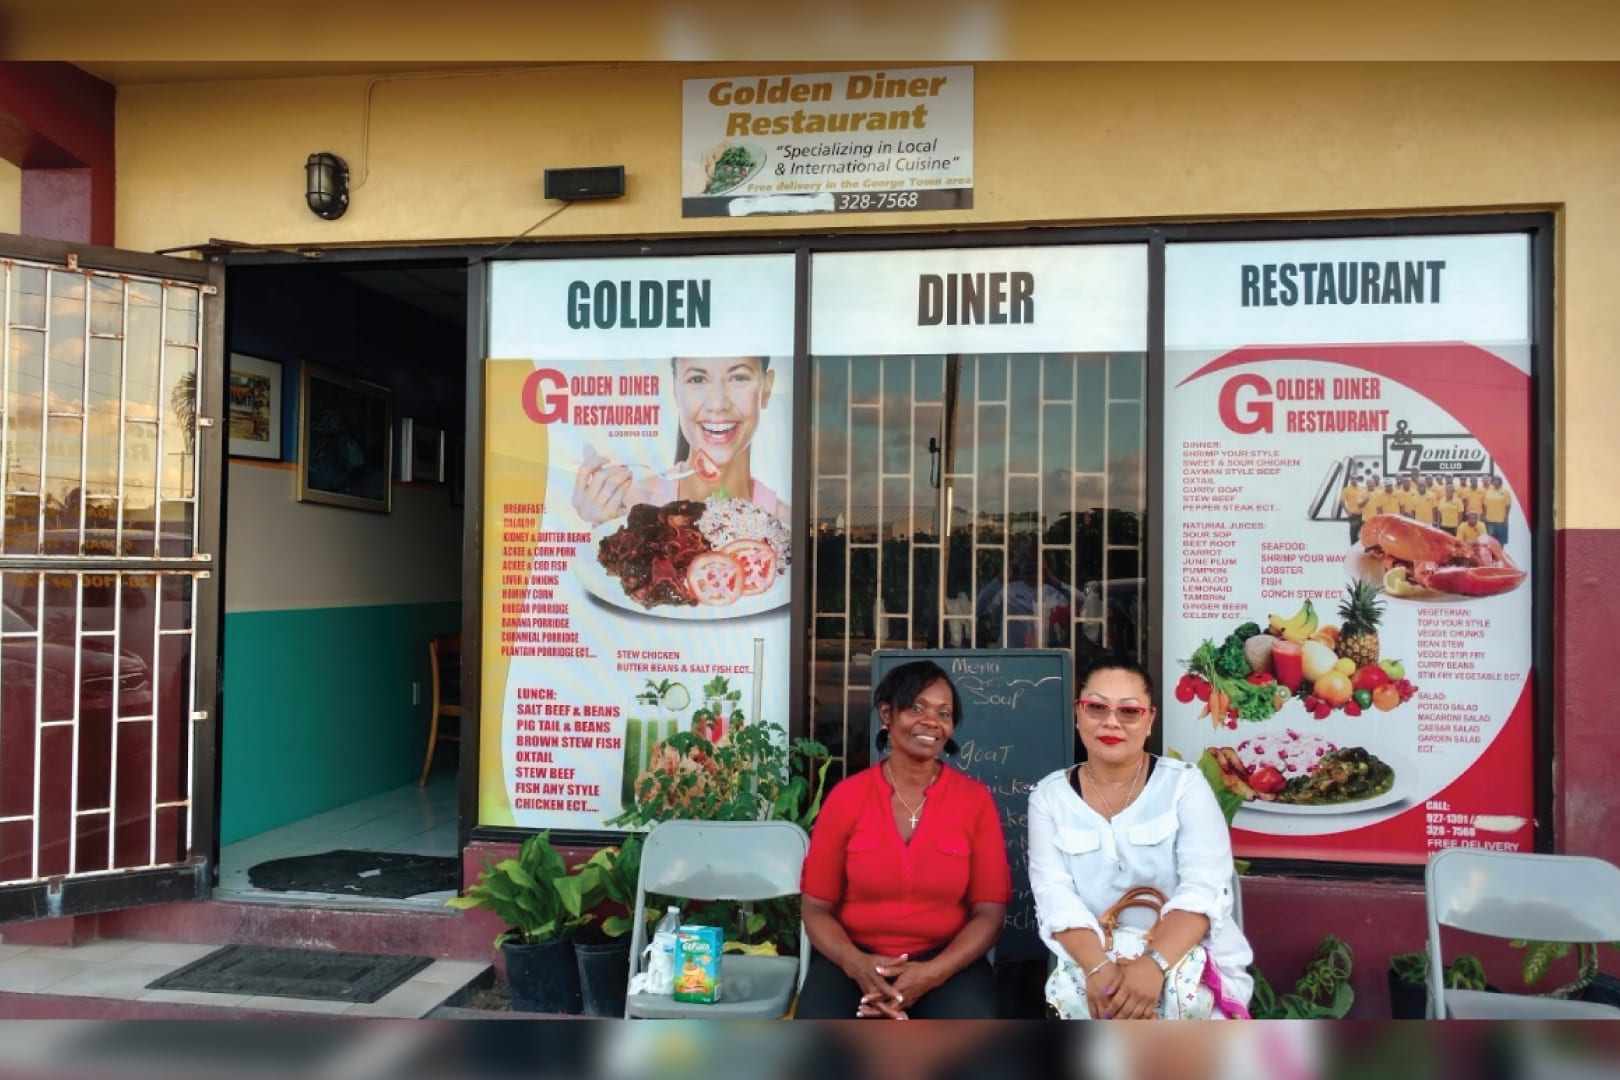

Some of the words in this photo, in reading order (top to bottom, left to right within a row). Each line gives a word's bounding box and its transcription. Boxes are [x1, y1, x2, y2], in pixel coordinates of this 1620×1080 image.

[709, 78, 832, 106] Golden
[846, 72, 947, 100] Diner
[726, 104, 928, 137] Restaurant
[878, 141, 892, 154] in
[897, 138, 937, 154] Local
[775, 163, 785, 176] &
[791, 159, 891, 175] International
[747, 183, 773, 192] Free
[776, 181, 827, 192] delivery
[826, 179, 836, 188] in
[841, 179, 859, 188] the
[863, 178, 904, 189] George
[909, 178, 942, 186] Town
[945, 177, 972, 185] area
[839, 192, 918, 209] 328-7568
[1241, 261, 1447, 307] RESTAURANT
[568, 280, 711, 330] GOLDEN
[917, 270, 1035, 327] DINER
[619, 376, 660, 396] DINER
[1333, 377, 1381, 401] DINER
[574, 405, 660, 426] RESTAURANT
[1287, 410, 1389, 433] RESTAURANT
[1394, 420, 1412, 443] &
[1439, 462, 1463, 470] CLUB
[537, 533, 565, 543] BUTTER
[567, 533, 591, 543] BEANS
[1261, 554, 1296, 562] SHRIMP
[1298, 554, 1324, 562] YOUR
[1326, 555, 1346, 563] WAY
[534, 561, 549, 570] COD
[551, 561, 567, 571] FISH
[1261, 566, 1303, 574] LOBSTER
[1261, 590, 1294, 598] CONCH
[1296, 590, 1323, 598] STEW
[532, 604, 568, 614] PORRIDGE
[502, 618, 531, 627] BANANA
[533, 618, 569, 628] PORRIDGE
[1442, 619, 1463, 627] YOUR
[501, 632, 540, 642] CORNMEAL
[542, 632, 578, 643] PORRIDGE
[1450, 630, 1485, 638] CHUNKS
[501, 647, 535, 656] PLANTAIN
[537, 647, 574, 657] PORRIDGE
[617, 650, 640, 660] STEW
[642, 651, 680, 660] CHICKEN
[617, 663, 648, 672] BUTTER
[651, 663, 679, 672] BEANS
[681, 664, 687, 672] &
[690, 664, 710, 673] SALT
[712, 665, 731, 673] FISH
[951, 657, 1000, 675] Menu
[1418, 661, 1444, 669] CURRY
[1455, 672, 1502, 680] VEGETABLE
[517, 688, 557, 700] LUNCH:
[963, 686, 1024, 710] Soup
[517, 704, 542, 716] SALT
[545, 705, 571, 716] BEEF
[573, 707, 581, 717] &
[584, 705, 620, 717] BEANS
[517, 720, 535, 732] PIG
[538, 720, 561, 732] TAIL
[564, 722, 572, 733] &
[574, 721, 610, 733] BEANS
[516, 736, 559, 747] BROWN
[561, 737, 593, 748] STEW
[596, 737, 621, 749] FISH
[1454, 735, 1481, 743] SALAD
[516, 752, 554, 764] OXTAIL
[515, 767, 548, 779] STEW
[550, 768, 575, 780] BEEF
[515, 782, 540, 794] FISH
[542, 783, 565, 795] ANY
[567, 784, 600, 796] STYLE
[515, 798, 565, 811] CHICKEN
[1426, 801, 1450, 810] CALL:
[1427, 839, 1457, 849] FREE
[1461, 840, 1519, 852] DELIVERY
